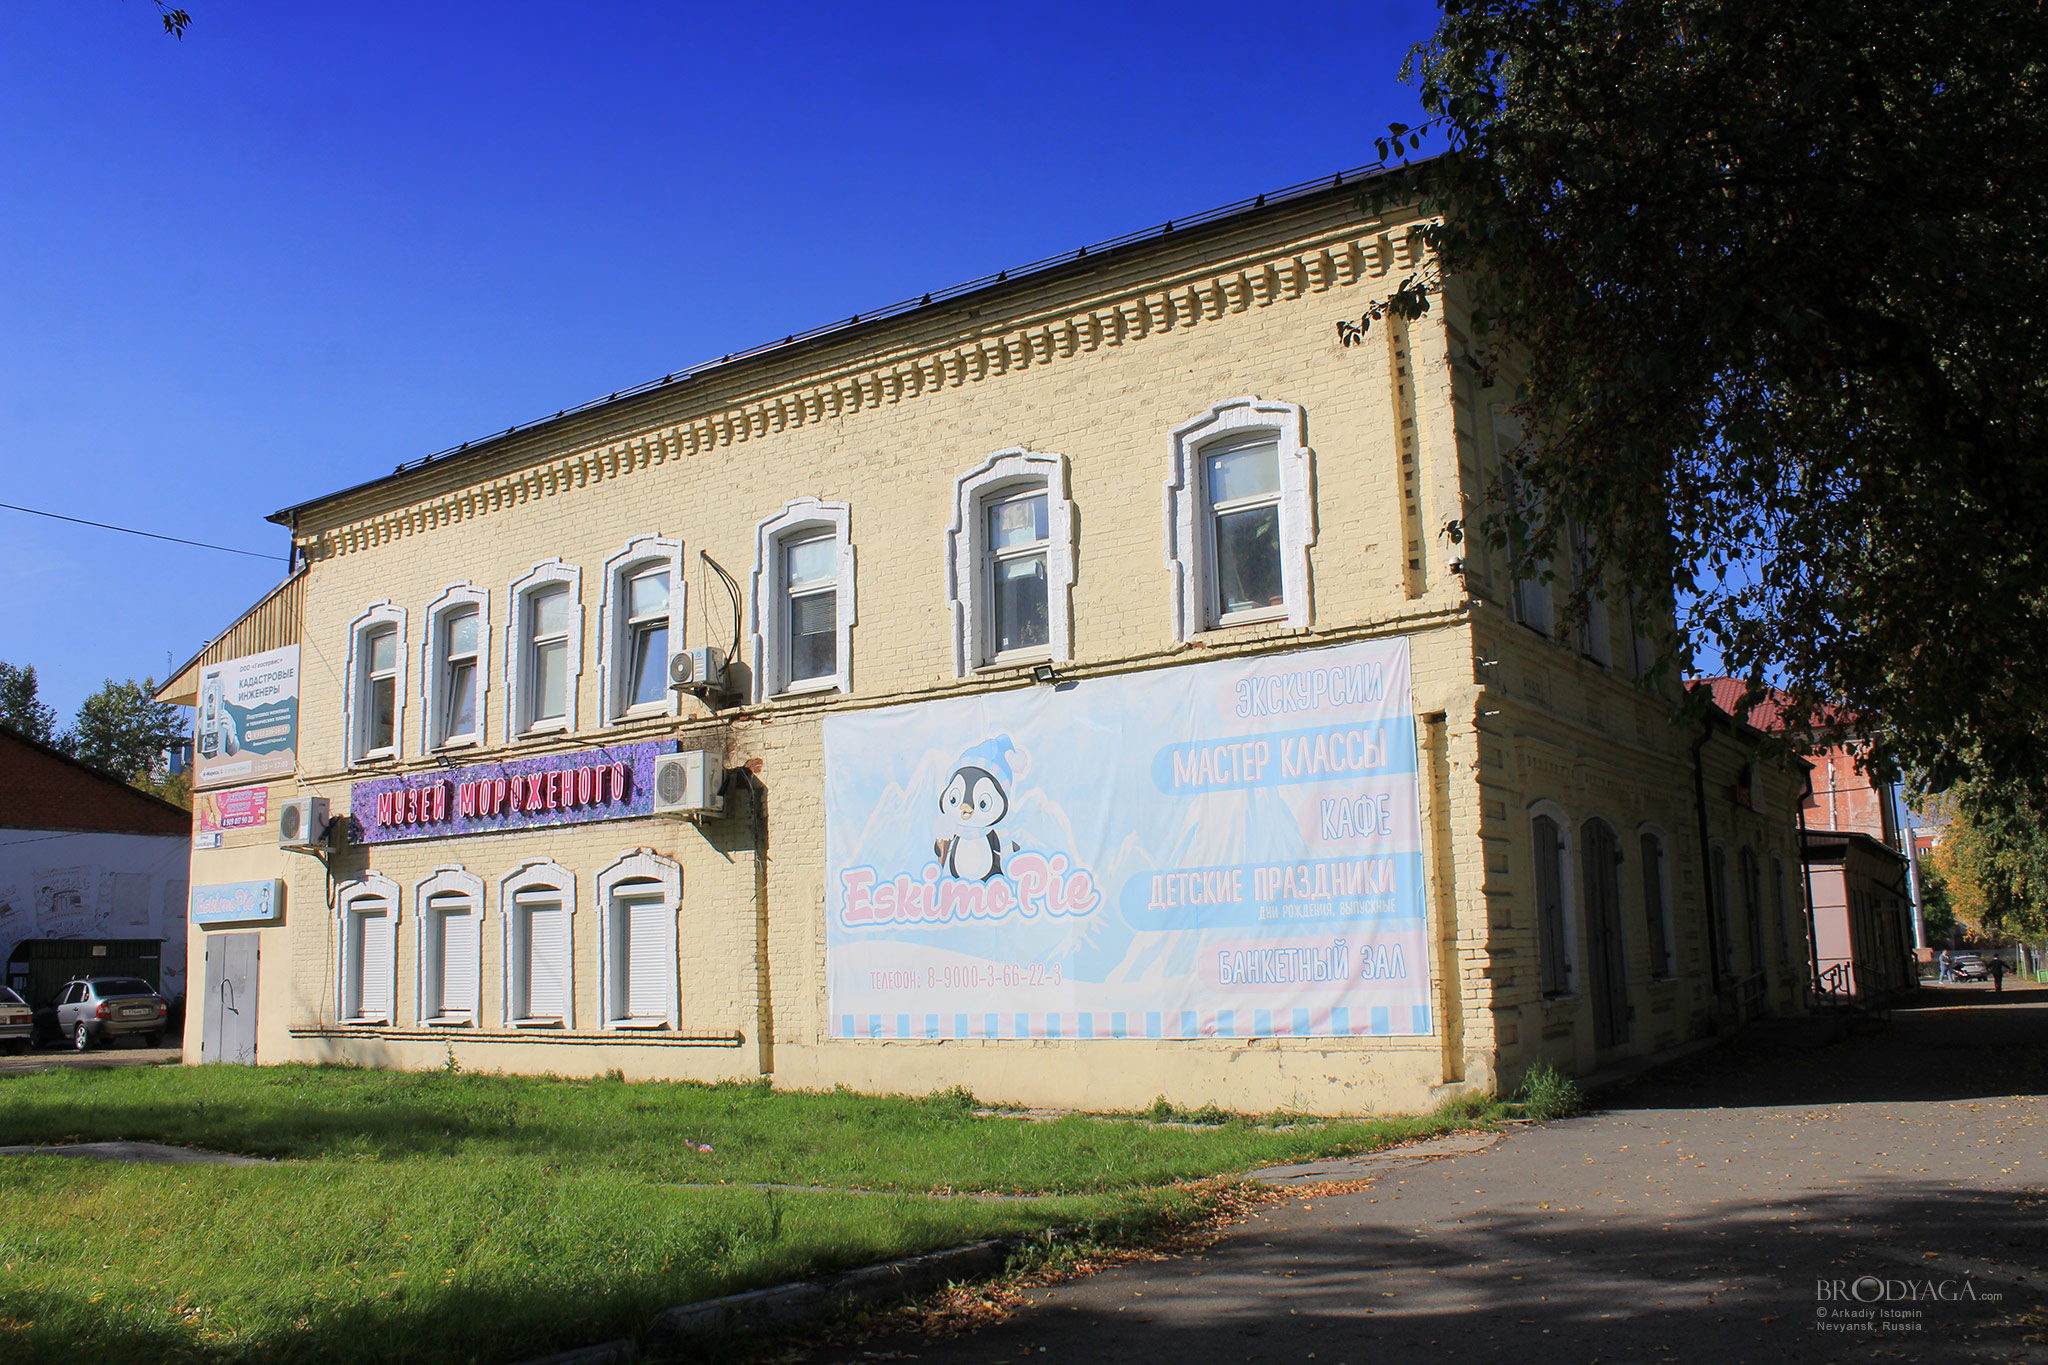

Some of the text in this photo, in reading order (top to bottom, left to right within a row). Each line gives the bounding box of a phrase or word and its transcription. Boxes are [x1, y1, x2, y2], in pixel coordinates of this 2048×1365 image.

[238, 668, 294, 688] КАДАСТРОВЫЕ
[238, 684, 280, 702] ИНЖЕНЕРЫ
[1235, 661, 1383, 718] ЭКСКУРСИИ
[1172, 727, 1387, 788] МАСТЕР КЛАССЫ
[377, 761, 626, 827] МУЗЕЙ МОРОЖЕНОГО
[1321, 793, 1392, 840] КАФЕ
[842, 852, 1100, 924] Eskimo Pie
[1147, 858, 1396, 910] ДЕТСКИЕ ПРАЗДНИКИ
[1259, 898, 1396, 921] ДНИ РОЖДЕНИЯ, ВЫПУСКНЫЕ
[869, 962, 1062, 990] ТЕЛЕФОН: 8-9000-3-66-22-3
[1218, 939, 1407, 985] БАНКЕТНЫЙ ЗАЛ
